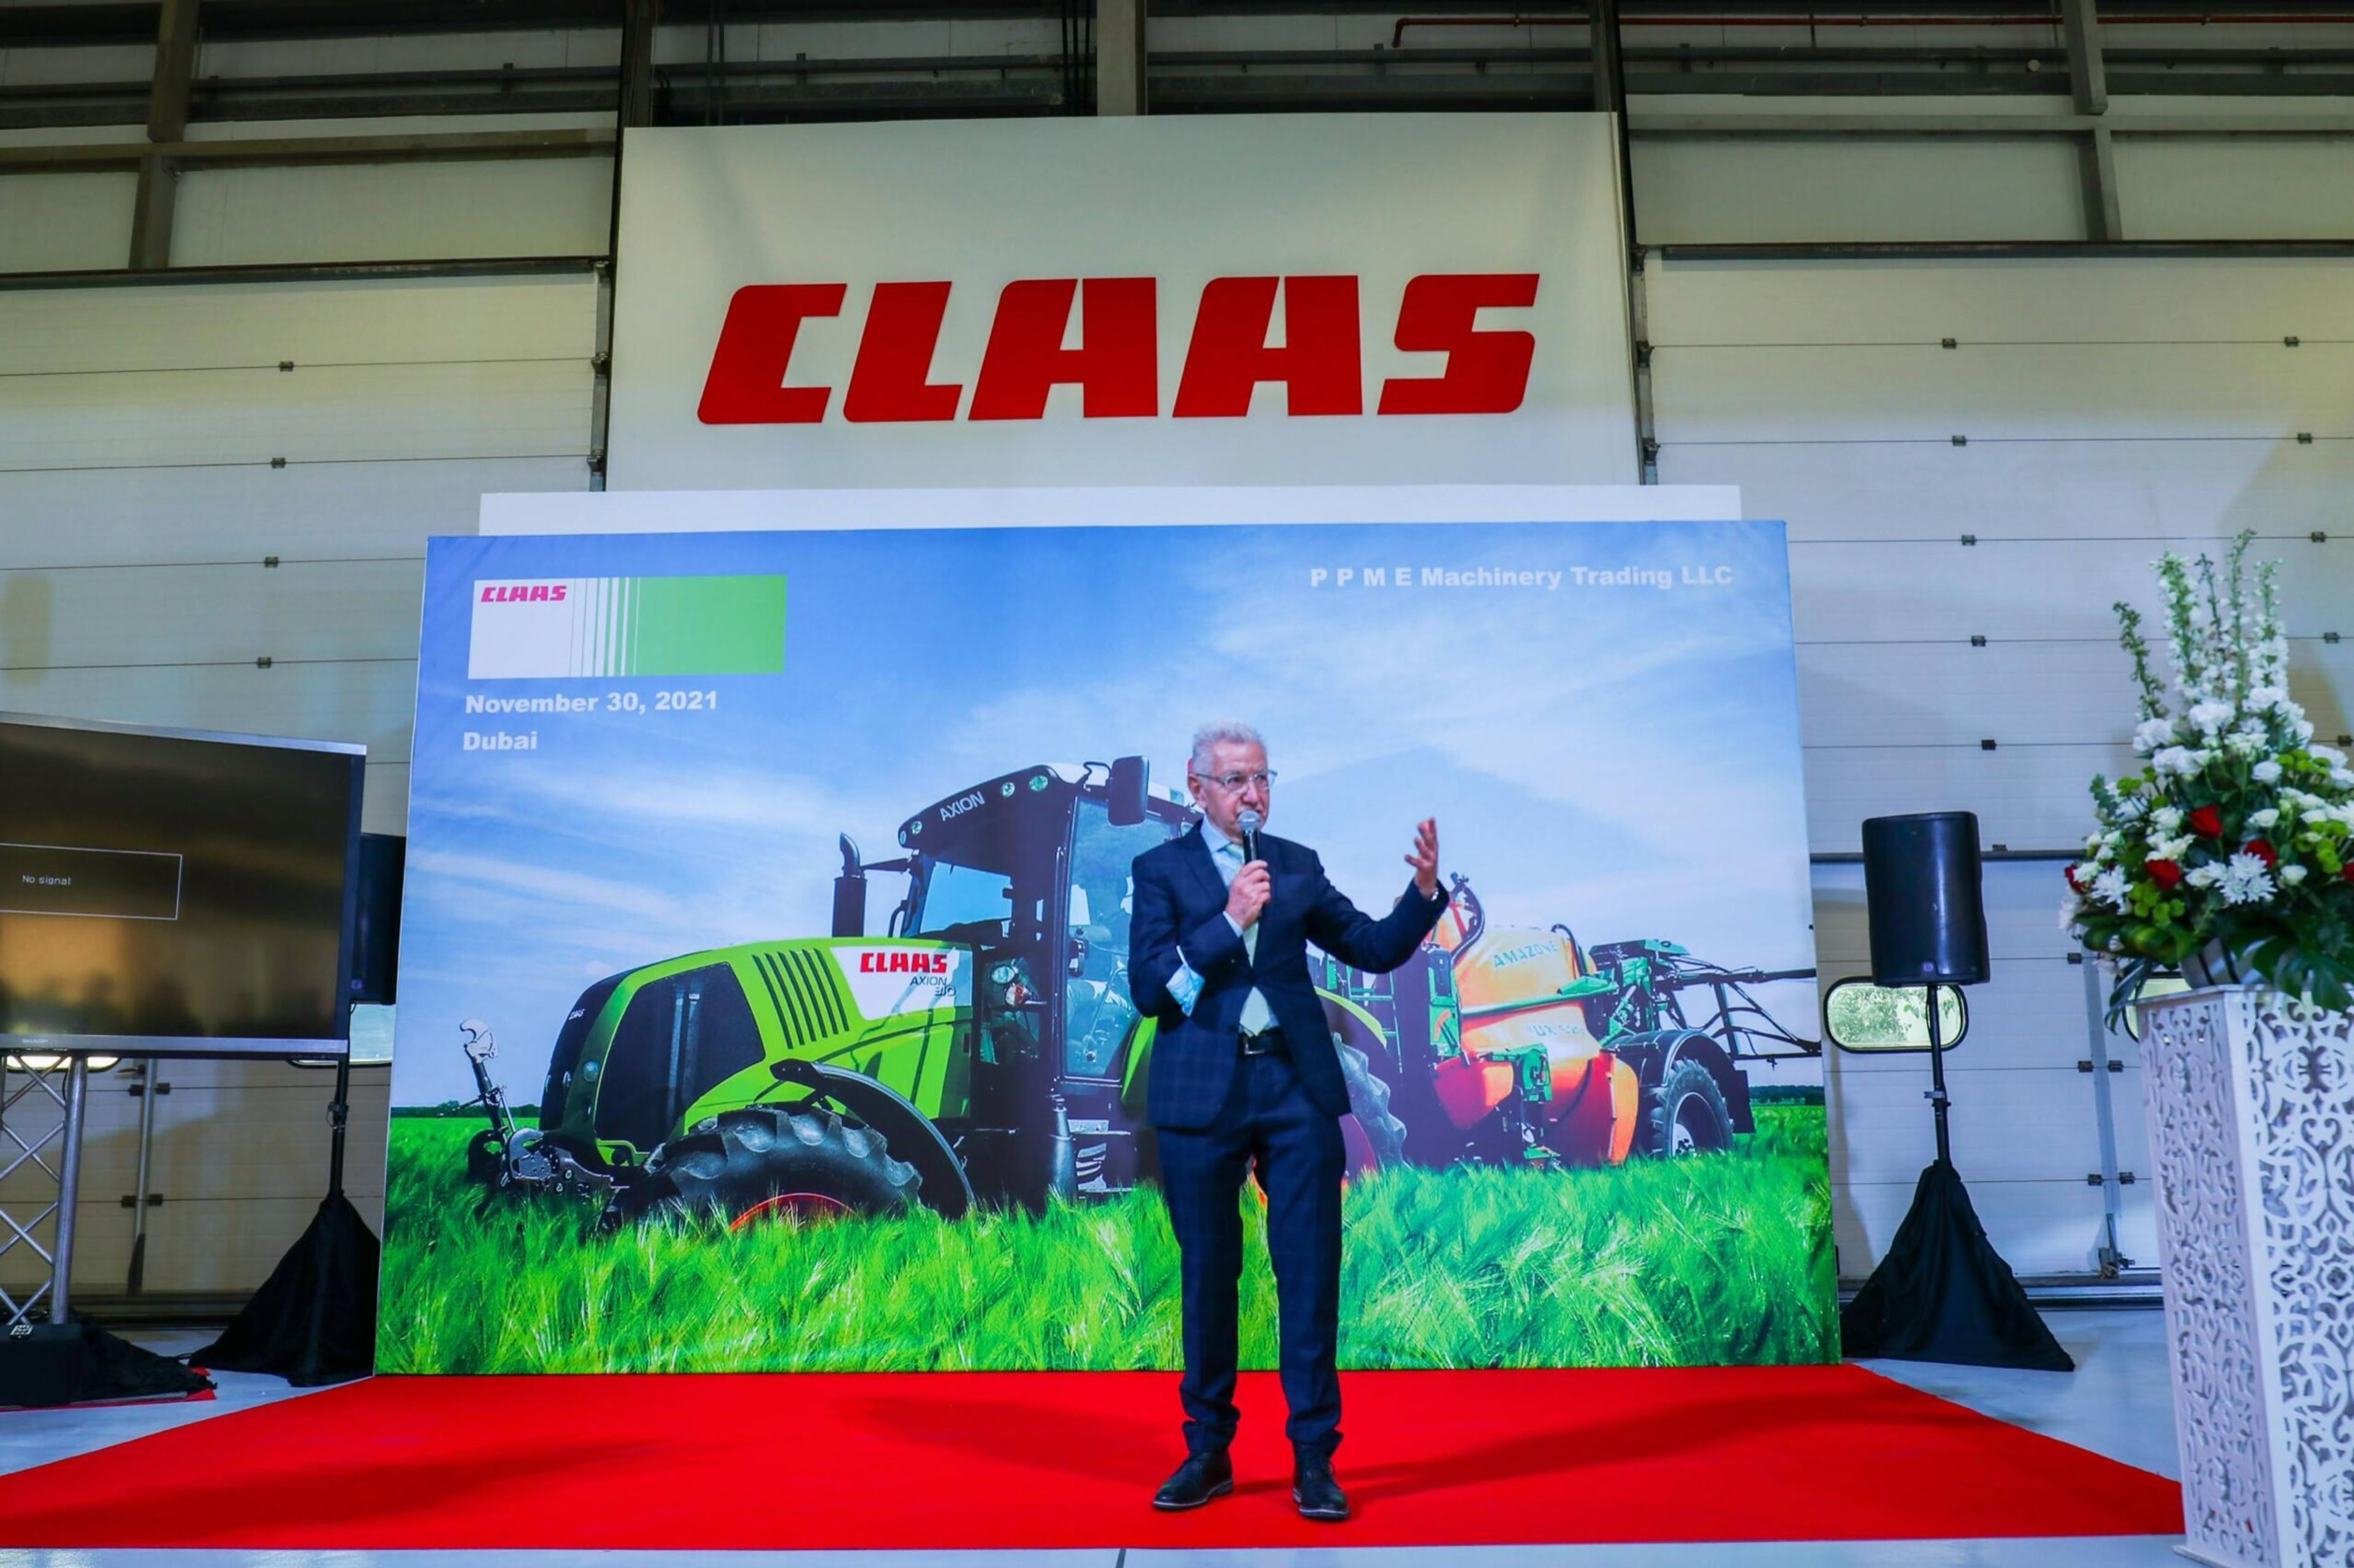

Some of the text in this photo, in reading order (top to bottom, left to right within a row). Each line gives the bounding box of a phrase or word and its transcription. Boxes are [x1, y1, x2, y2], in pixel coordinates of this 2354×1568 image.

[697, 273, 1540, 425] CLAAS
[1311, 565, 1734, 590] P P M E Machinery Trading LLC
[481, 585, 567, 602] CLAAS
[465, 690, 718, 715] November 30, 2021
[463, 731, 538, 752] Dubai
[939, 791, 985, 821] AXION
[22, 875, 70, 885] No signal
[860, 952, 947, 973] CLAAS
[910, 976, 947, 986] AXION
